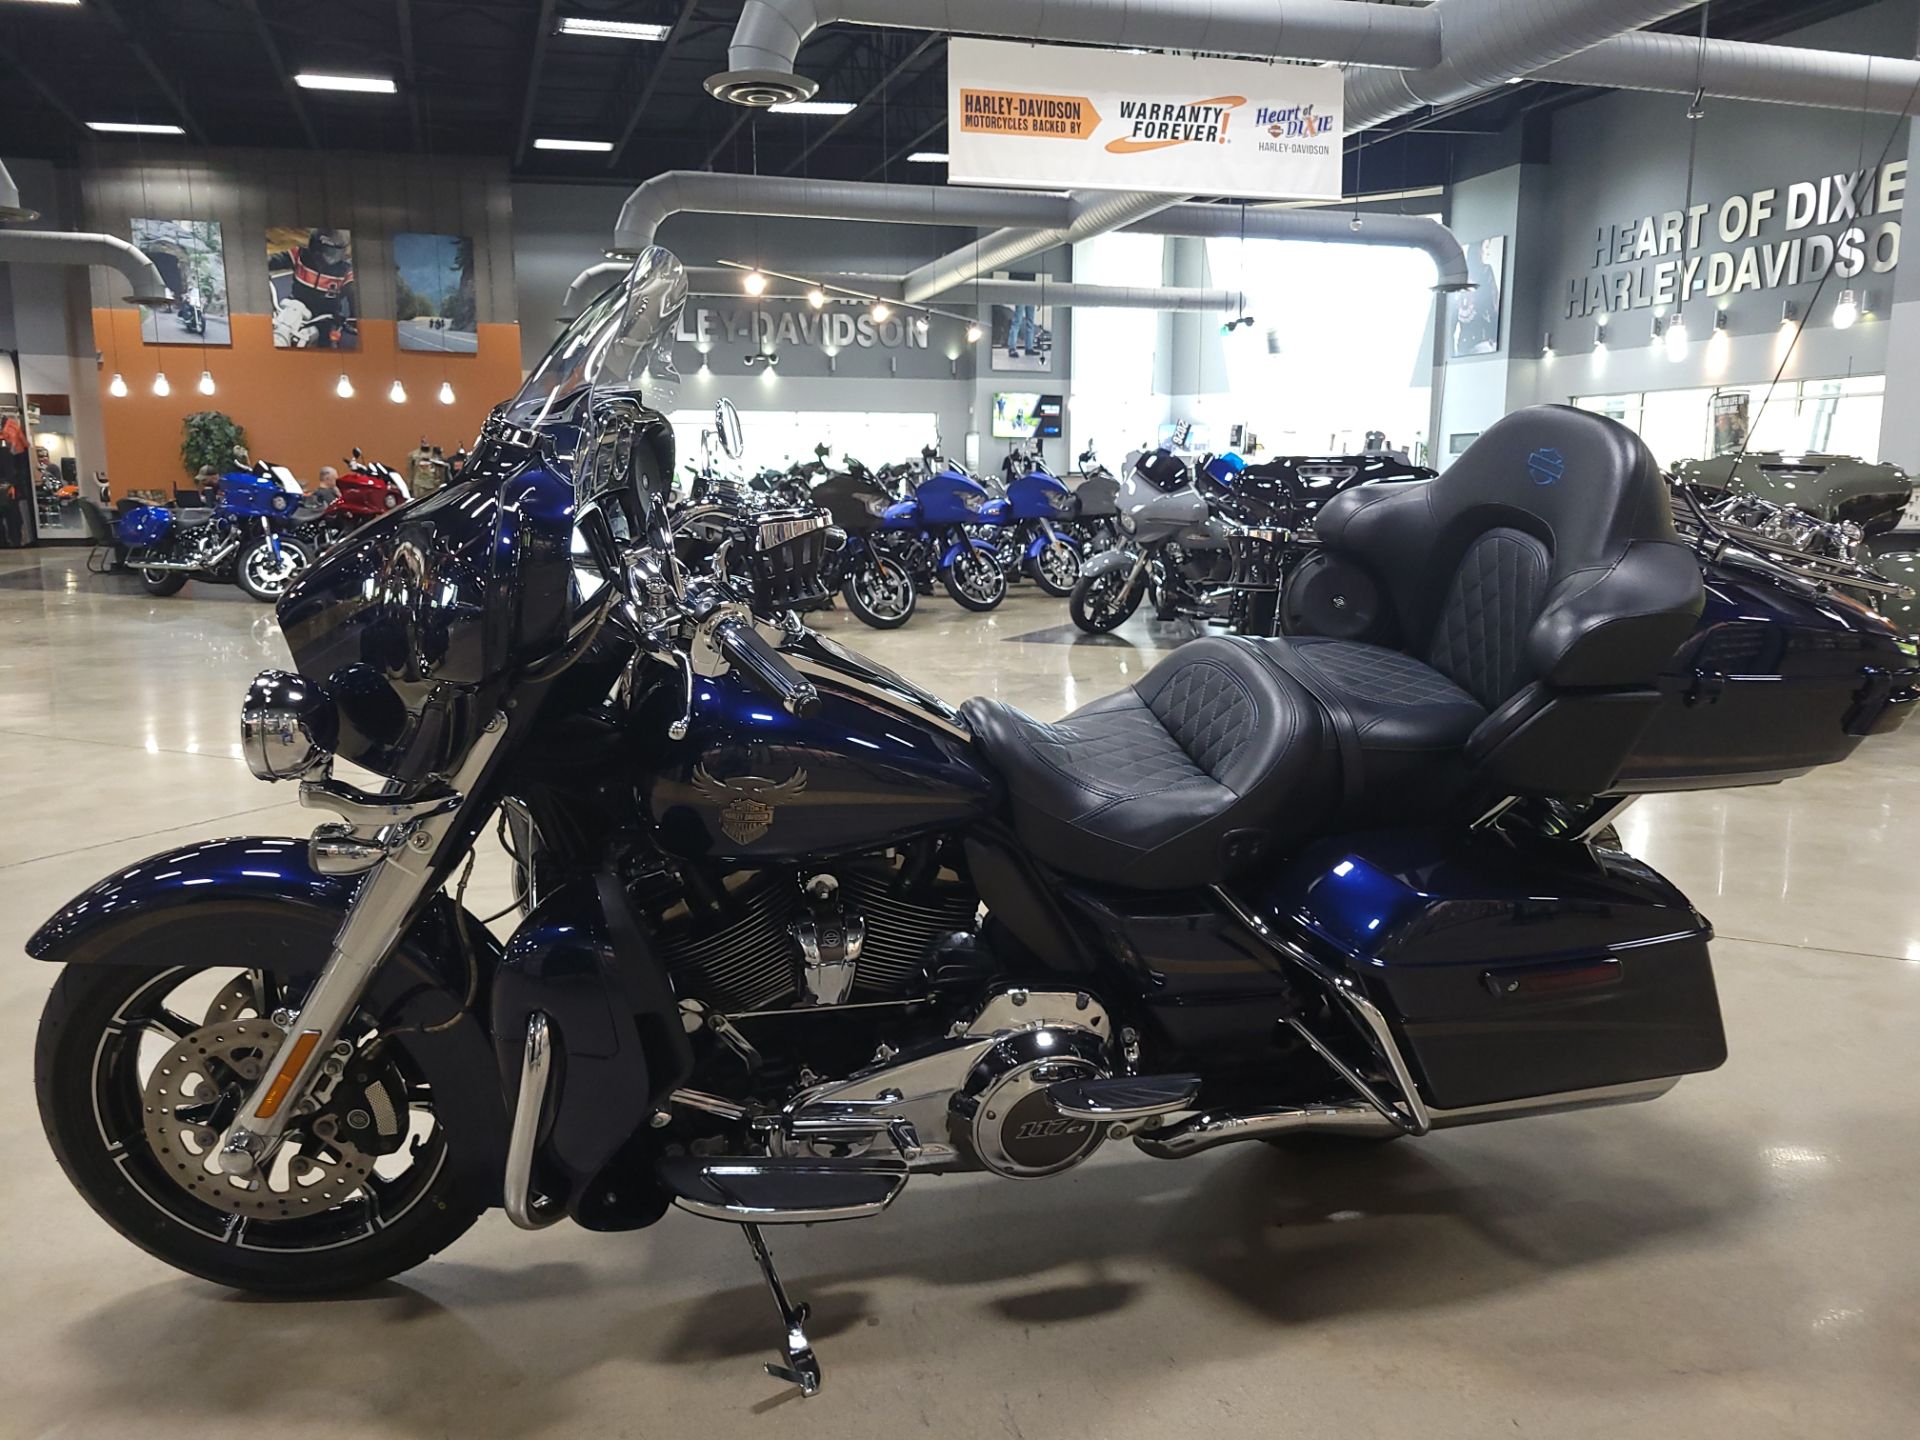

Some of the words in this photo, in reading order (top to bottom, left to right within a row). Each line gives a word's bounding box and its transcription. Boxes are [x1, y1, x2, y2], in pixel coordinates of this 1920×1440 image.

[965, 94, 1081, 120] HARLEY-DAVIDSON
[1119, 101, 1223, 124] WARRANTY
[1255, 106, 1300, 126] Heart
[1302, 104, 1314, 116] of
[965, 115, 1028, 131] MOTORCYCLES
[1032, 119, 1066, 133] BACKED
[1070, 122, 1081, 134] BY
[1132, 113, 1230, 145] FOREVER!
[1286, 114, 1334, 138] DIXIE
[1258, 142, 1330, 155] HARLEY-DAVIDSON
[1591, 203, 1711, 269] HEART
[1718, 187, 1776, 244] OF
[1785, 160, 1908, 231] DIXIE
[1172, 419, 1190, 446] 2026
